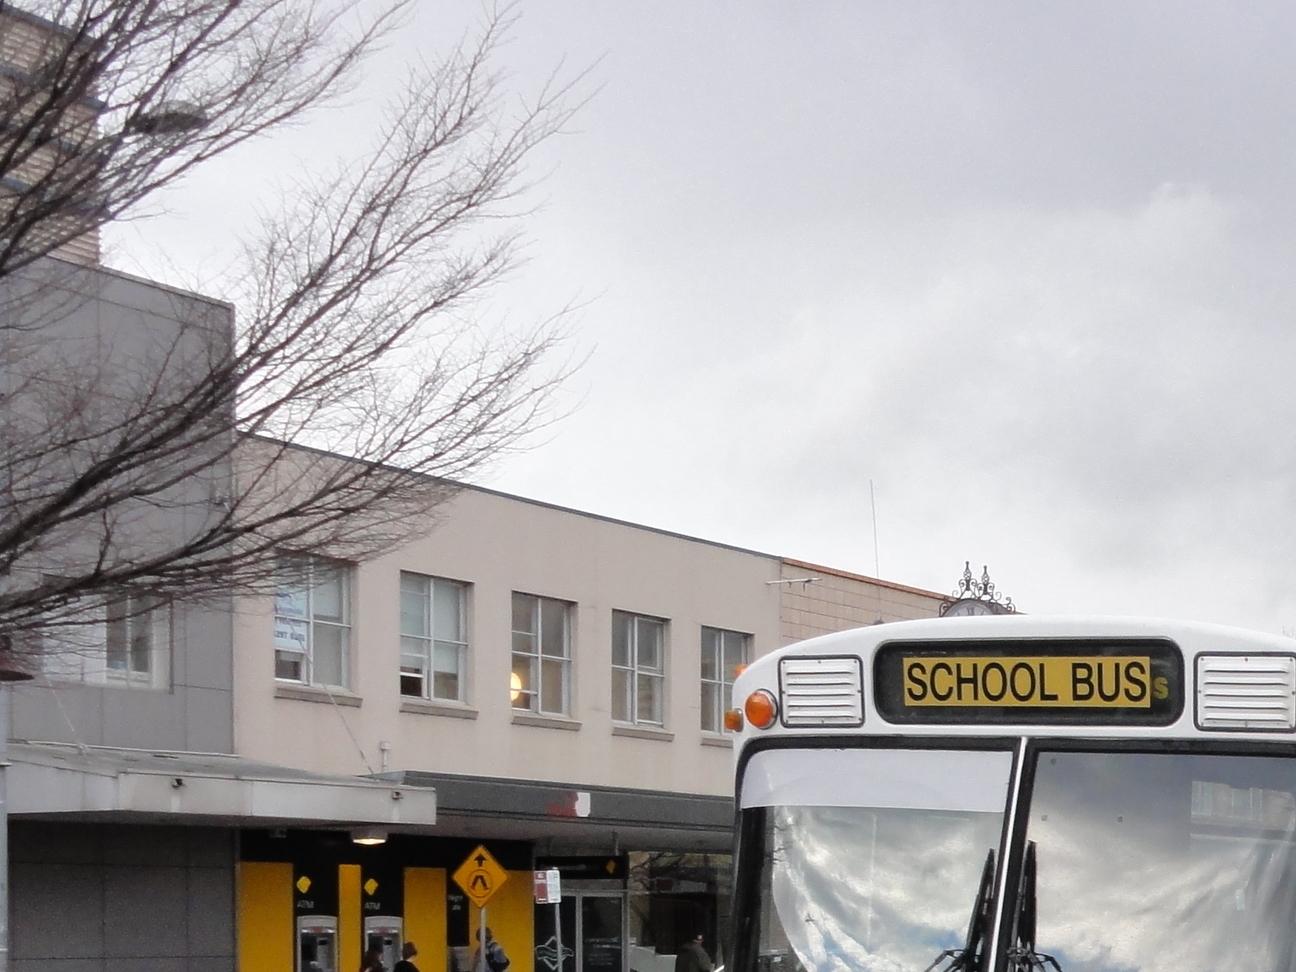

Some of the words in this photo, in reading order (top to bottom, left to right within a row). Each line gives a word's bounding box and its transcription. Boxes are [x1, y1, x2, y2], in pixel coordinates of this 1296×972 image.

[907, 662, 1059, 702] SCHOOL
[1071, 661, 1148, 702] BUS
[297, 900, 314, 909] ATM
[364, 902, 381, 910] ATM
